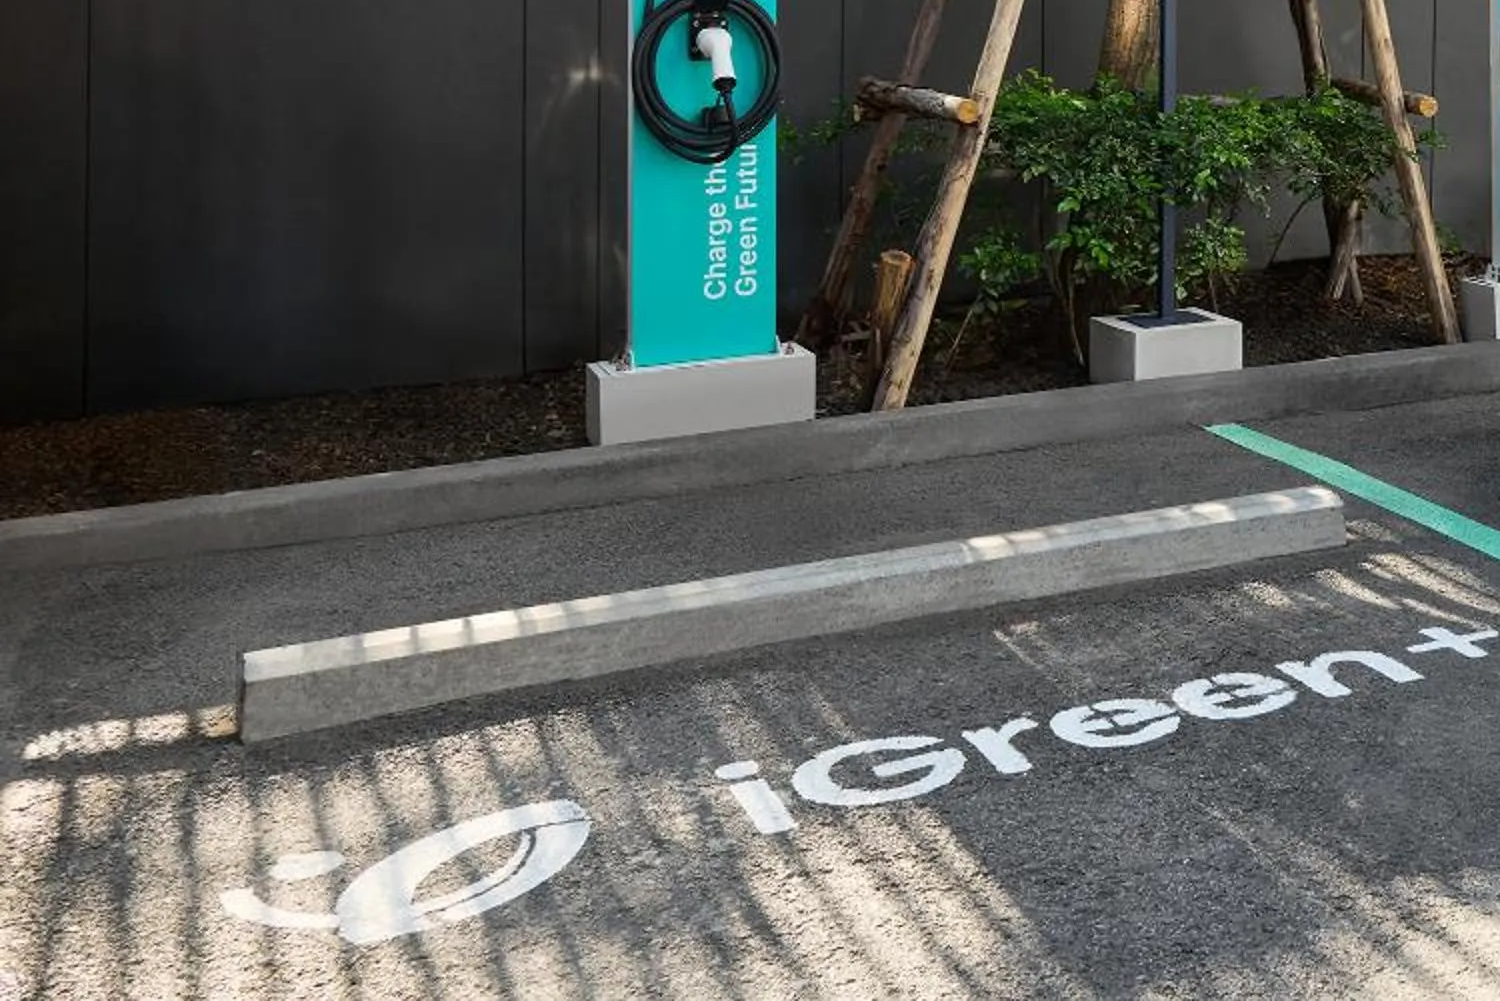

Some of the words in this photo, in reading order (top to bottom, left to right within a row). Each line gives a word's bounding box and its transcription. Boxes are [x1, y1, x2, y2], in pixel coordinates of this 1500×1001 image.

[735, 144, 758, 209] Futur
[704, 202, 733, 300] Charge
[734, 217, 758, 297] Green
[714, 623, 1500, 836] iGreen+
